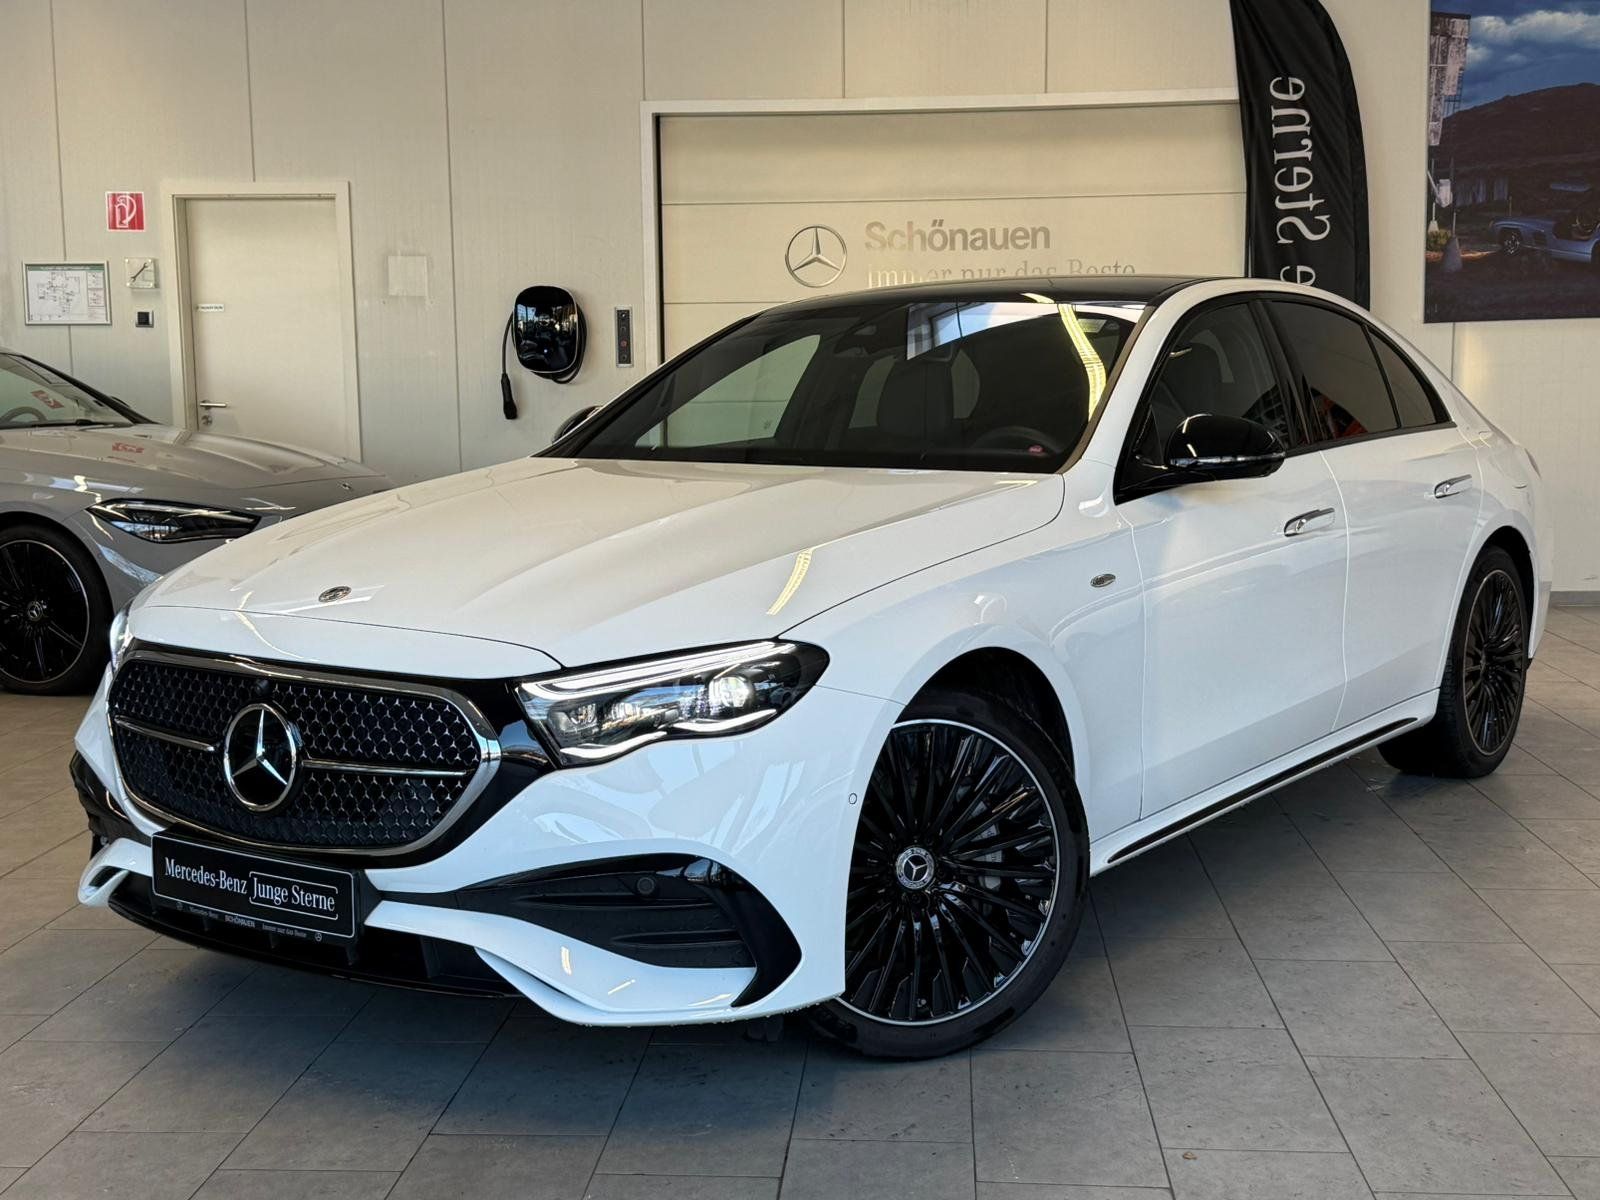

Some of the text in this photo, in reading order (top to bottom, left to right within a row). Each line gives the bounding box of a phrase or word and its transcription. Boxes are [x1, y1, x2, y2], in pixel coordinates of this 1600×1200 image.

[864, 218, 1051, 252] Schönauen
[164, 856, 335, 912] Mercedes-Benz Junge Sterne
